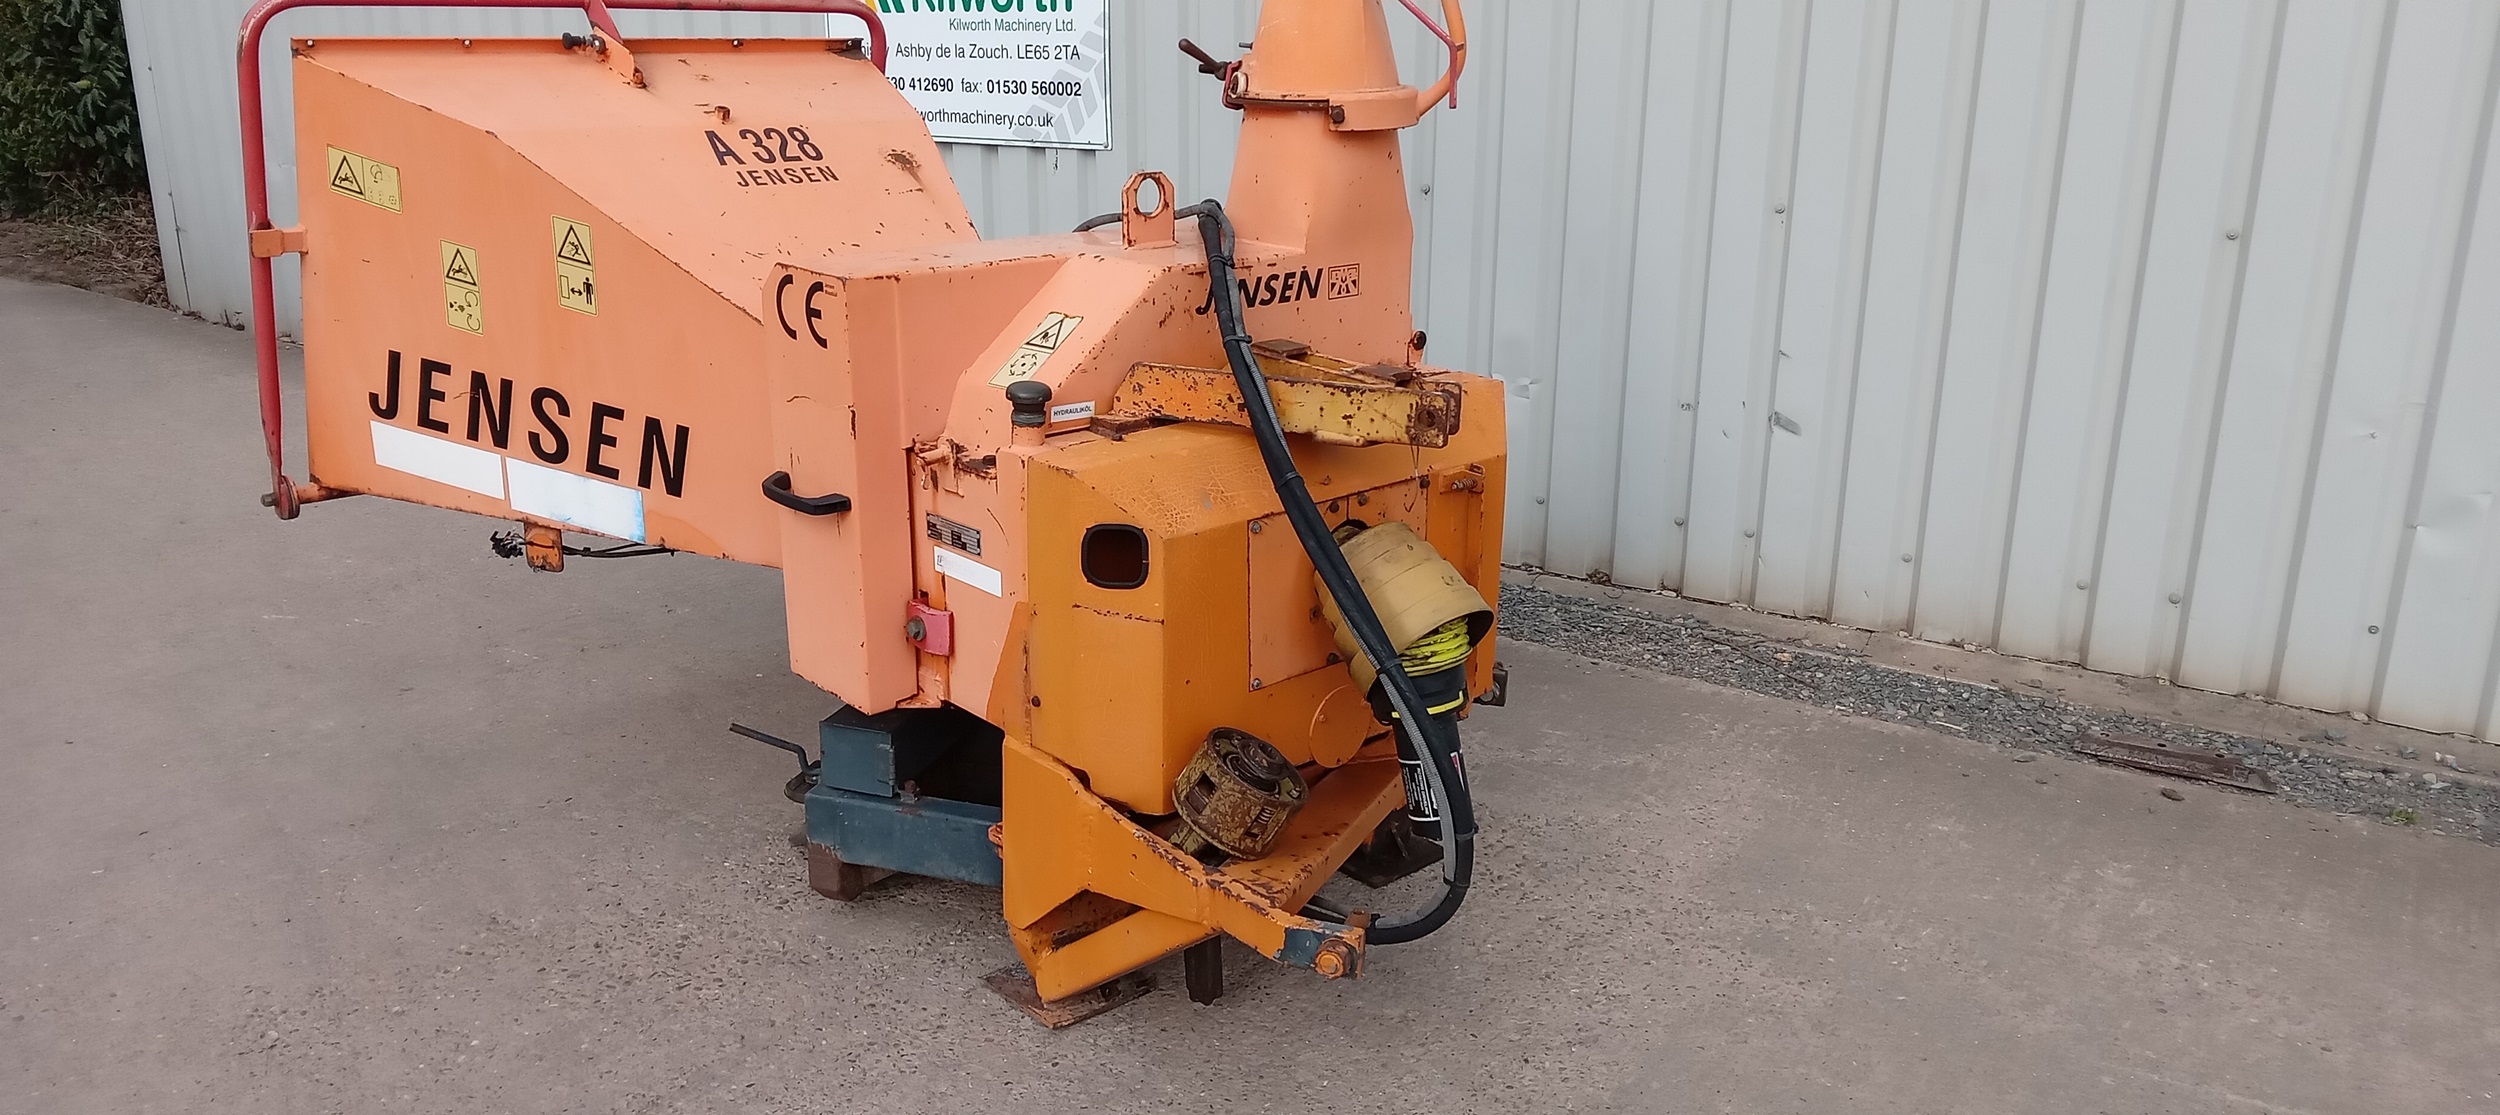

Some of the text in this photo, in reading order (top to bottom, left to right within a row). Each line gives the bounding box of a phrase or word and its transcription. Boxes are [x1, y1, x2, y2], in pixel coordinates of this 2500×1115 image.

[949, 18, 1076, 35] Kilworth Machinery Ltd.
[895, 43, 932, 61] Ashby
[935, 44, 951, 58] de
[954, 43, 965, 58] la
[969, 44, 1012, 59] Zouch.
[1017, 44, 1050, 60] LE65
[1054, 45, 1080, 60] 2TA
[909, 77, 954, 92] 412690
[961, 77, 982, 93] fax:
[986, 79, 1027, 95] 01530
[1031, 80, 1082, 97] 560002
[704, 126, 824, 166] A 328
[736, 165, 840, 187] JENSEN
[1195, 267, 1324, 316] JNSEN
[776, 274, 828, 349] CE
[1053, 405, 1092, 416] HYDRAULIKÖL
[368, 349, 690, 499] JENSEN
